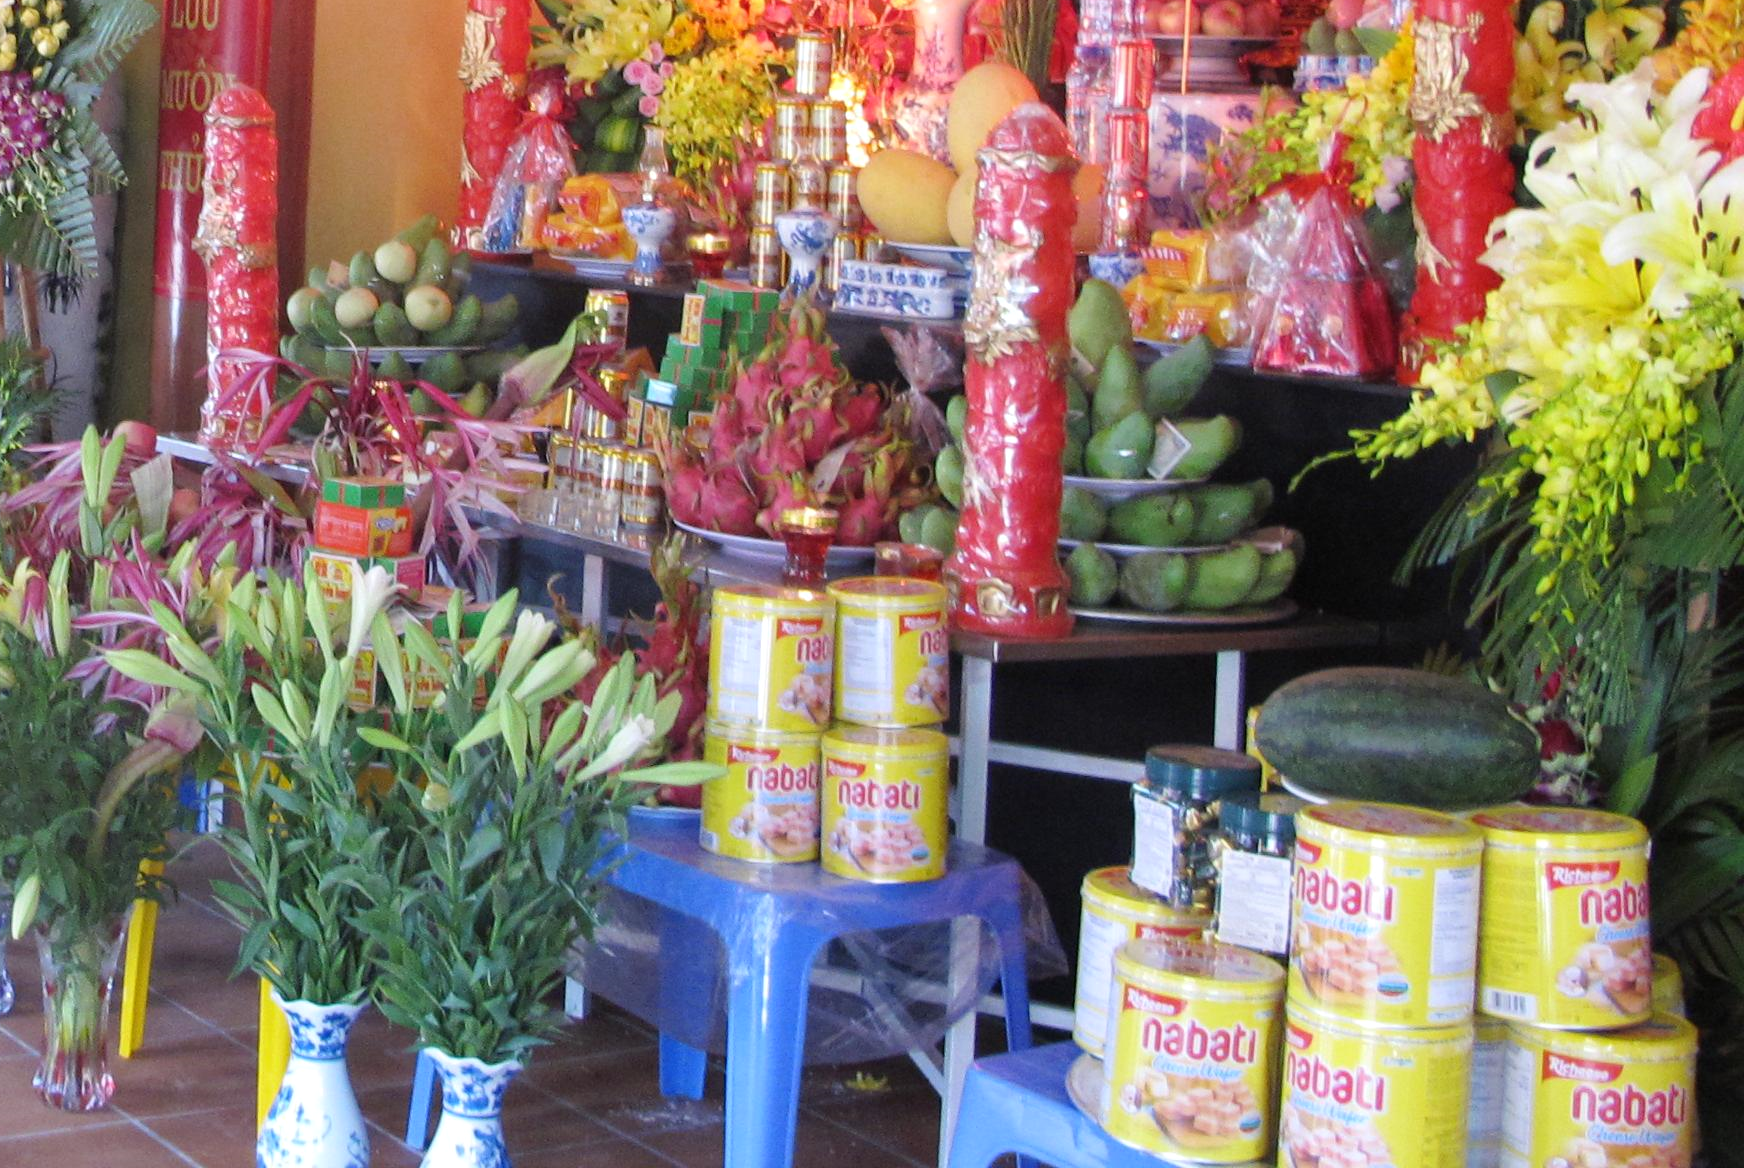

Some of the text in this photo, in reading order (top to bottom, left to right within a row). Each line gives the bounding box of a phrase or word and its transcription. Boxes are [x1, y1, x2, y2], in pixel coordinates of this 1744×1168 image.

[837, 779, 921, 810] nabati
[1296, 866, 1394, 922] nabati
[1142, 1016, 1257, 1064] nabati
[1287, 1050, 1385, 1112] nabati
[1571, 1082, 1686, 1127] nabati
